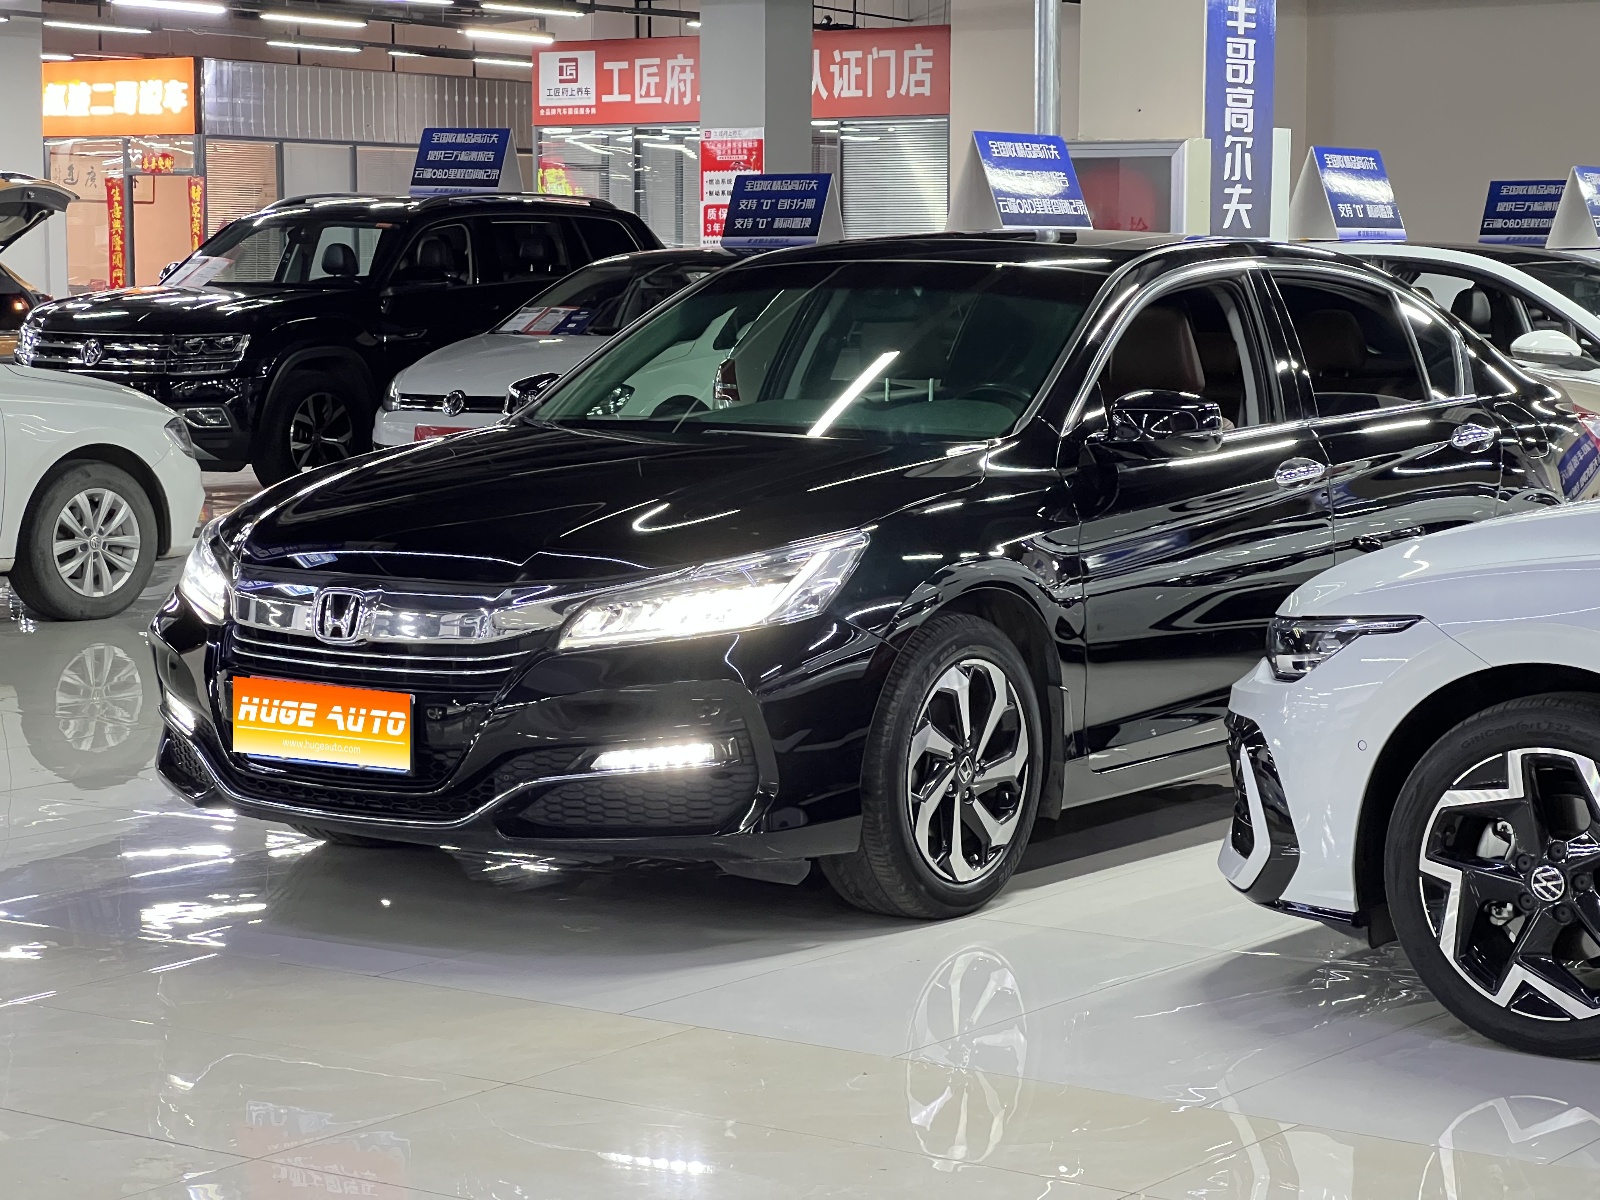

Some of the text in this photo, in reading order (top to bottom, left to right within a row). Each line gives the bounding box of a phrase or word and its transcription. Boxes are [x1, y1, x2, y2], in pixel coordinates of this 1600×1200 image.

[601, 54, 700, 105] 工匠府
[546, 87, 591, 97] 工匠府上养车
[431, 132, 500, 144] 全国收精品高尔夫
[988, 140, 1061, 160] 全国收精品高尔夫
[744, 179, 819, 192] 全国收精品高尔夫
